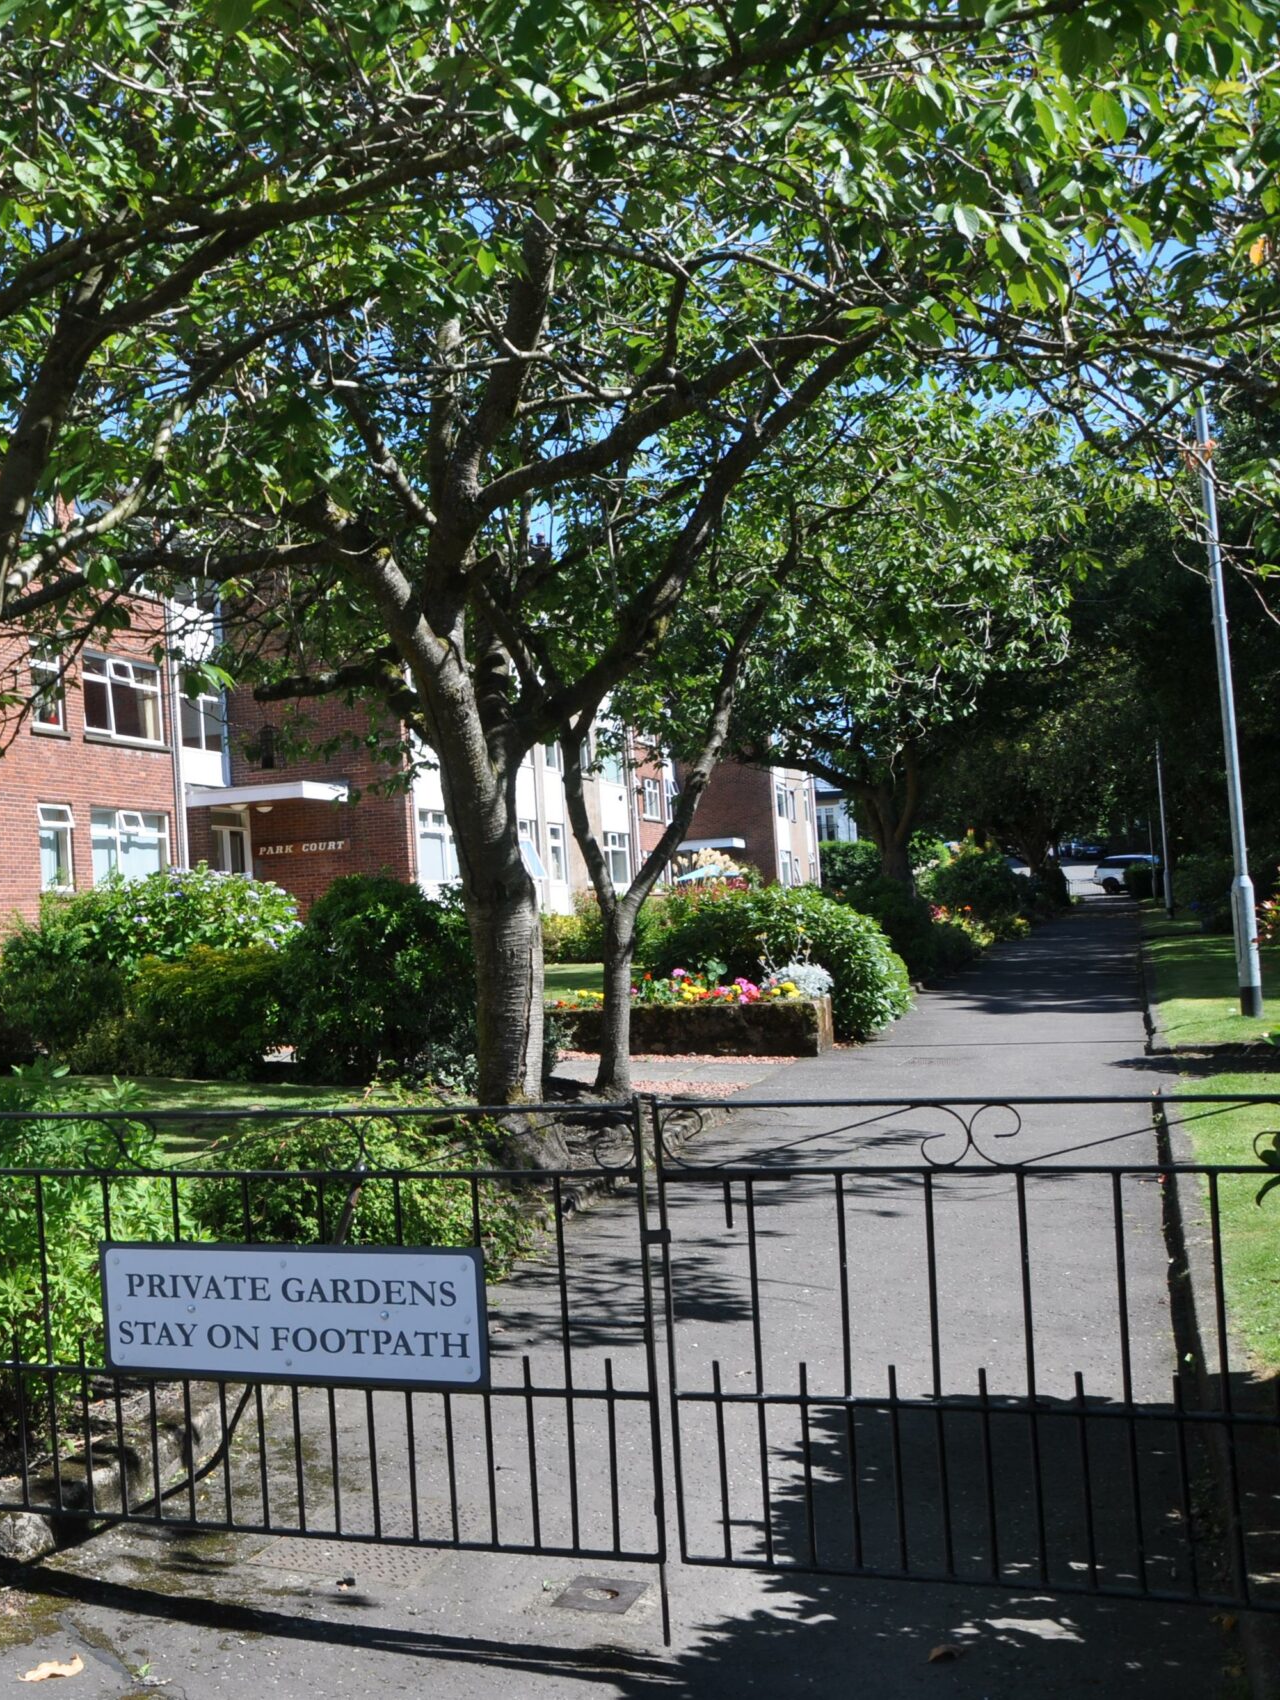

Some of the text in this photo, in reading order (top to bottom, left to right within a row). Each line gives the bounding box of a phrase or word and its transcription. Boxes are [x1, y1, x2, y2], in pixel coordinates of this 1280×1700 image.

[258, 840, 345, 855] PARK COURT
[125, 1273, 457, 1307] PRIVATE GARDENS
[118, 1320, 471, 1359] STAY ON FOOTPATH
